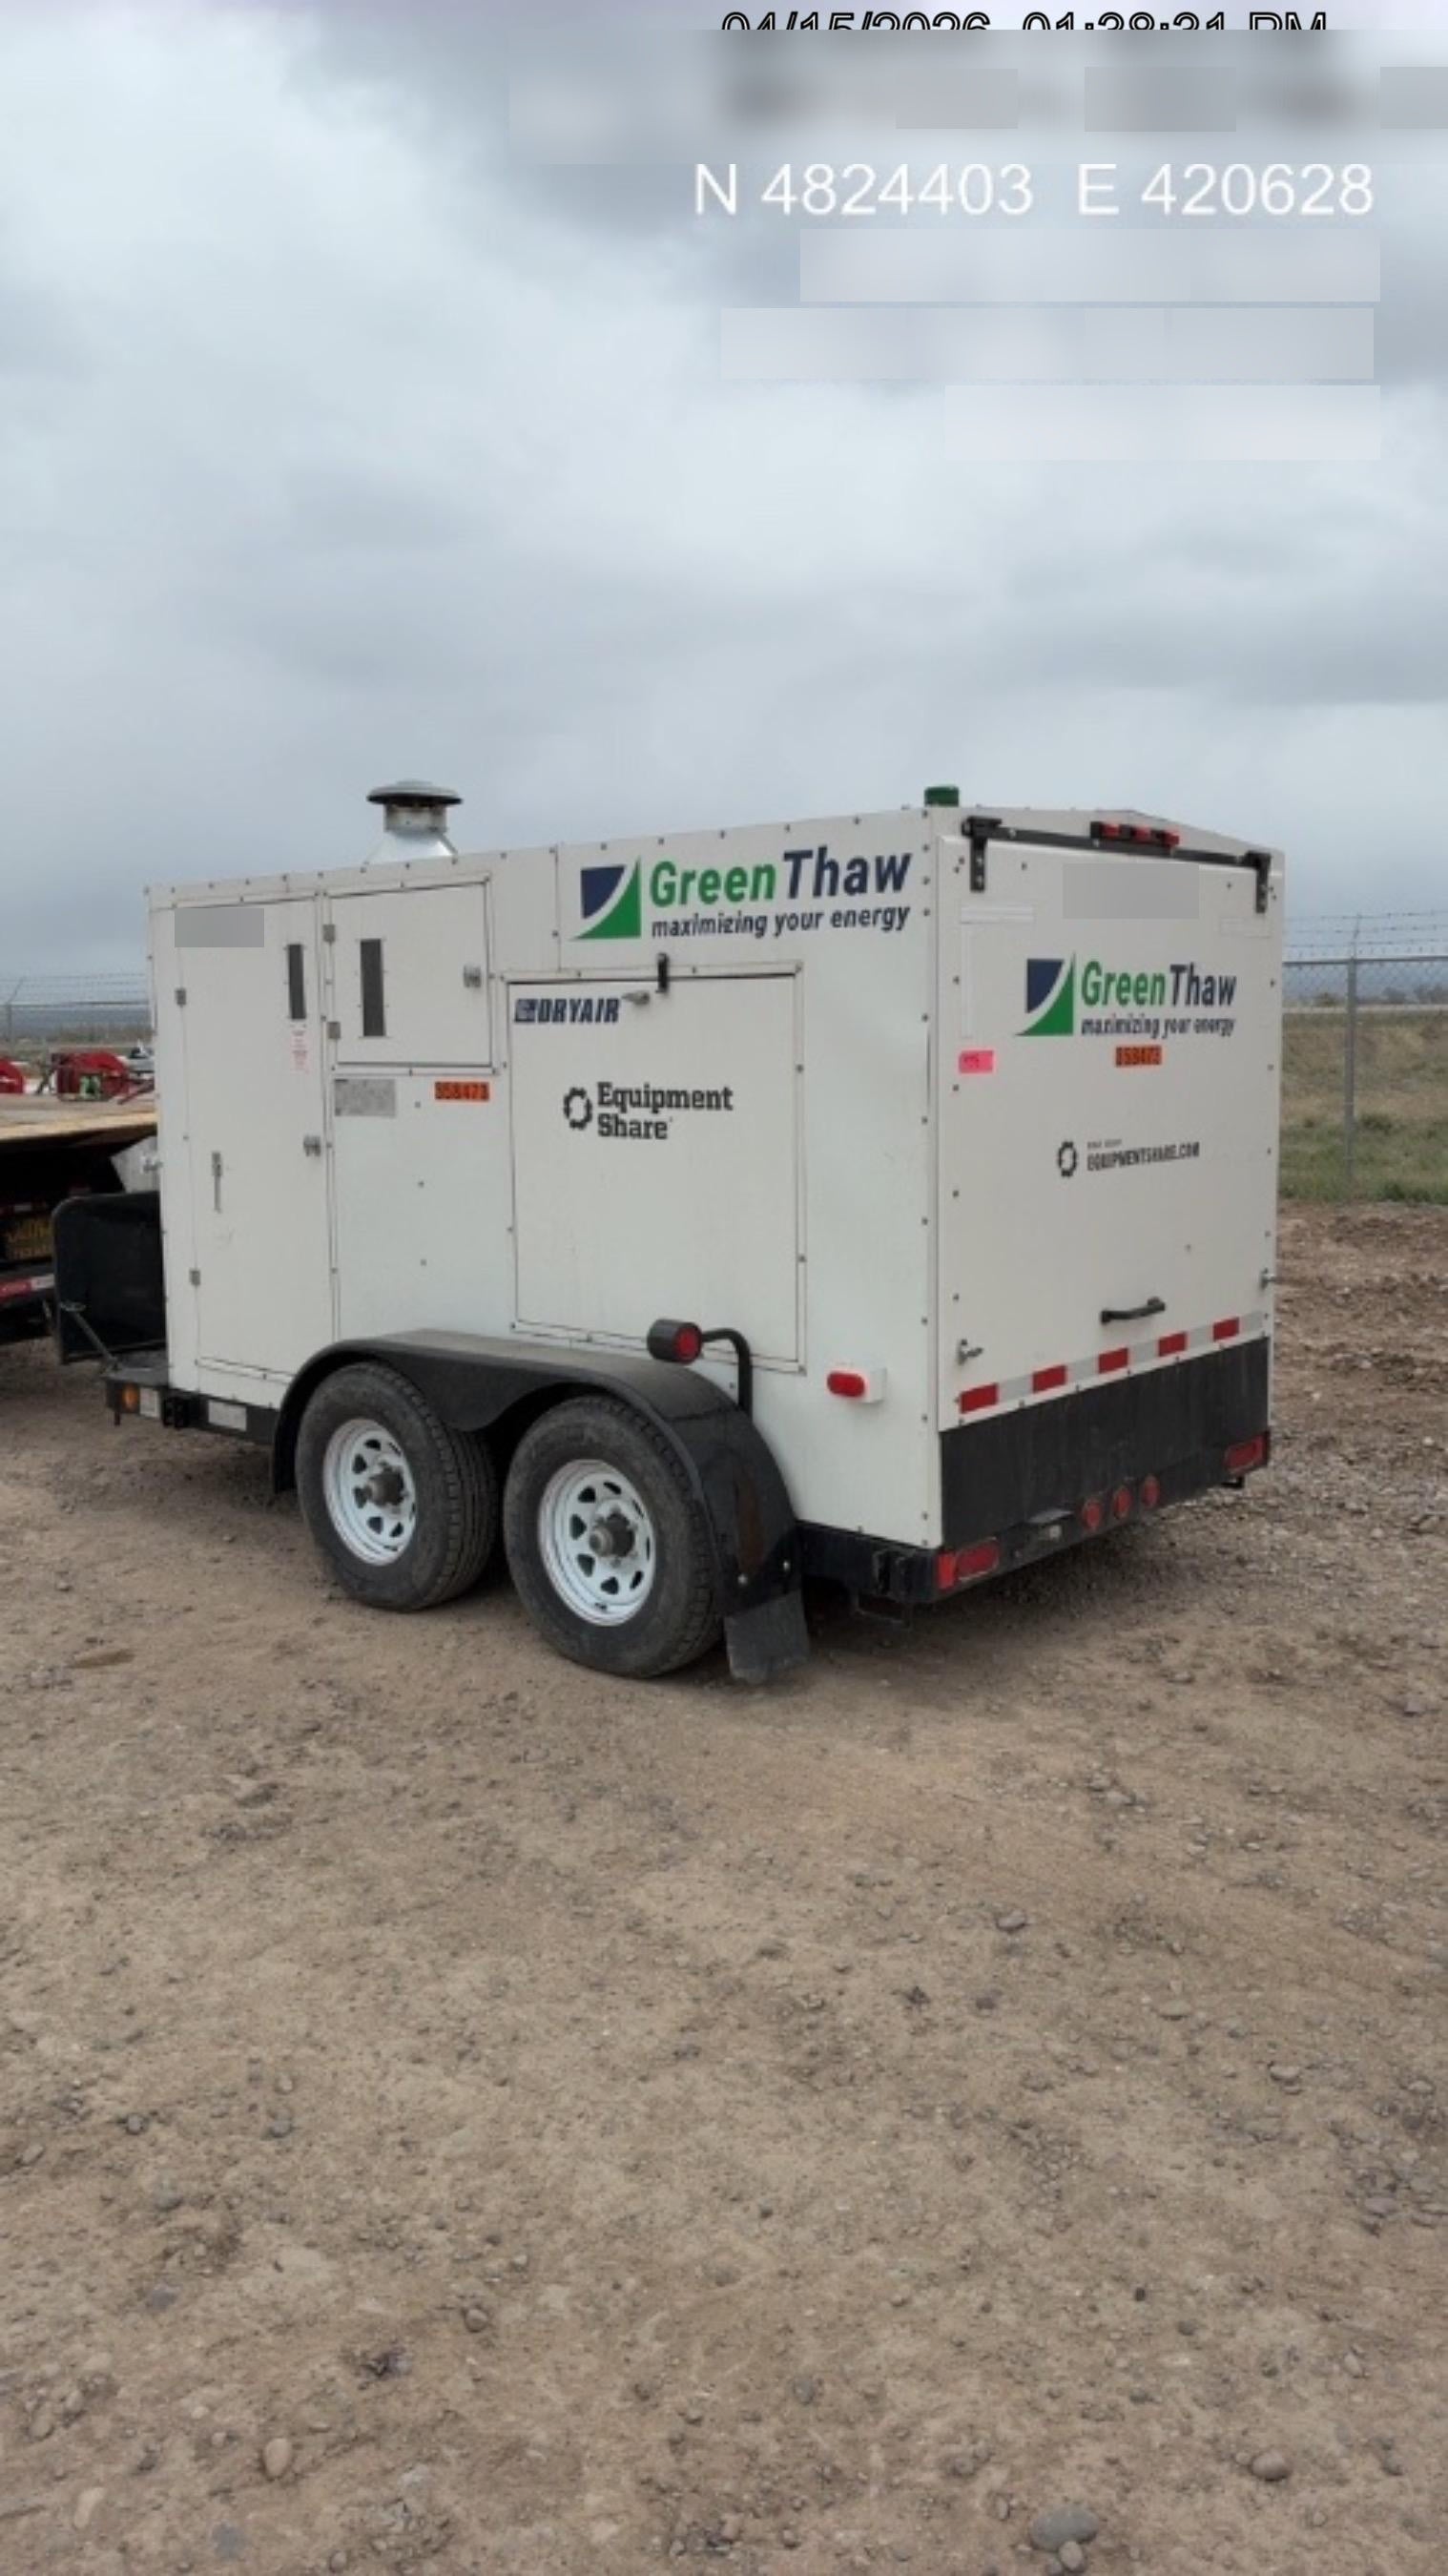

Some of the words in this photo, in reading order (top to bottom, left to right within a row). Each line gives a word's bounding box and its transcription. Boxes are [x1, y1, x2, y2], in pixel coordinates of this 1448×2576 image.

[651, 911, 768, 939] maximizing
[774, 911, 823, 938] your
[830, 905, 912, 932] energy
[537, 998, 621, 1024] DRYAIR
[1081, 1011, 1161, 1040] maximizing
[1162, 1017, 1191, 1040] your
[1193, 1017, 1237, 1038] energy
[597, 1081, 734, 1114] Equipment
[597, 1112, 669, 1140] Share
